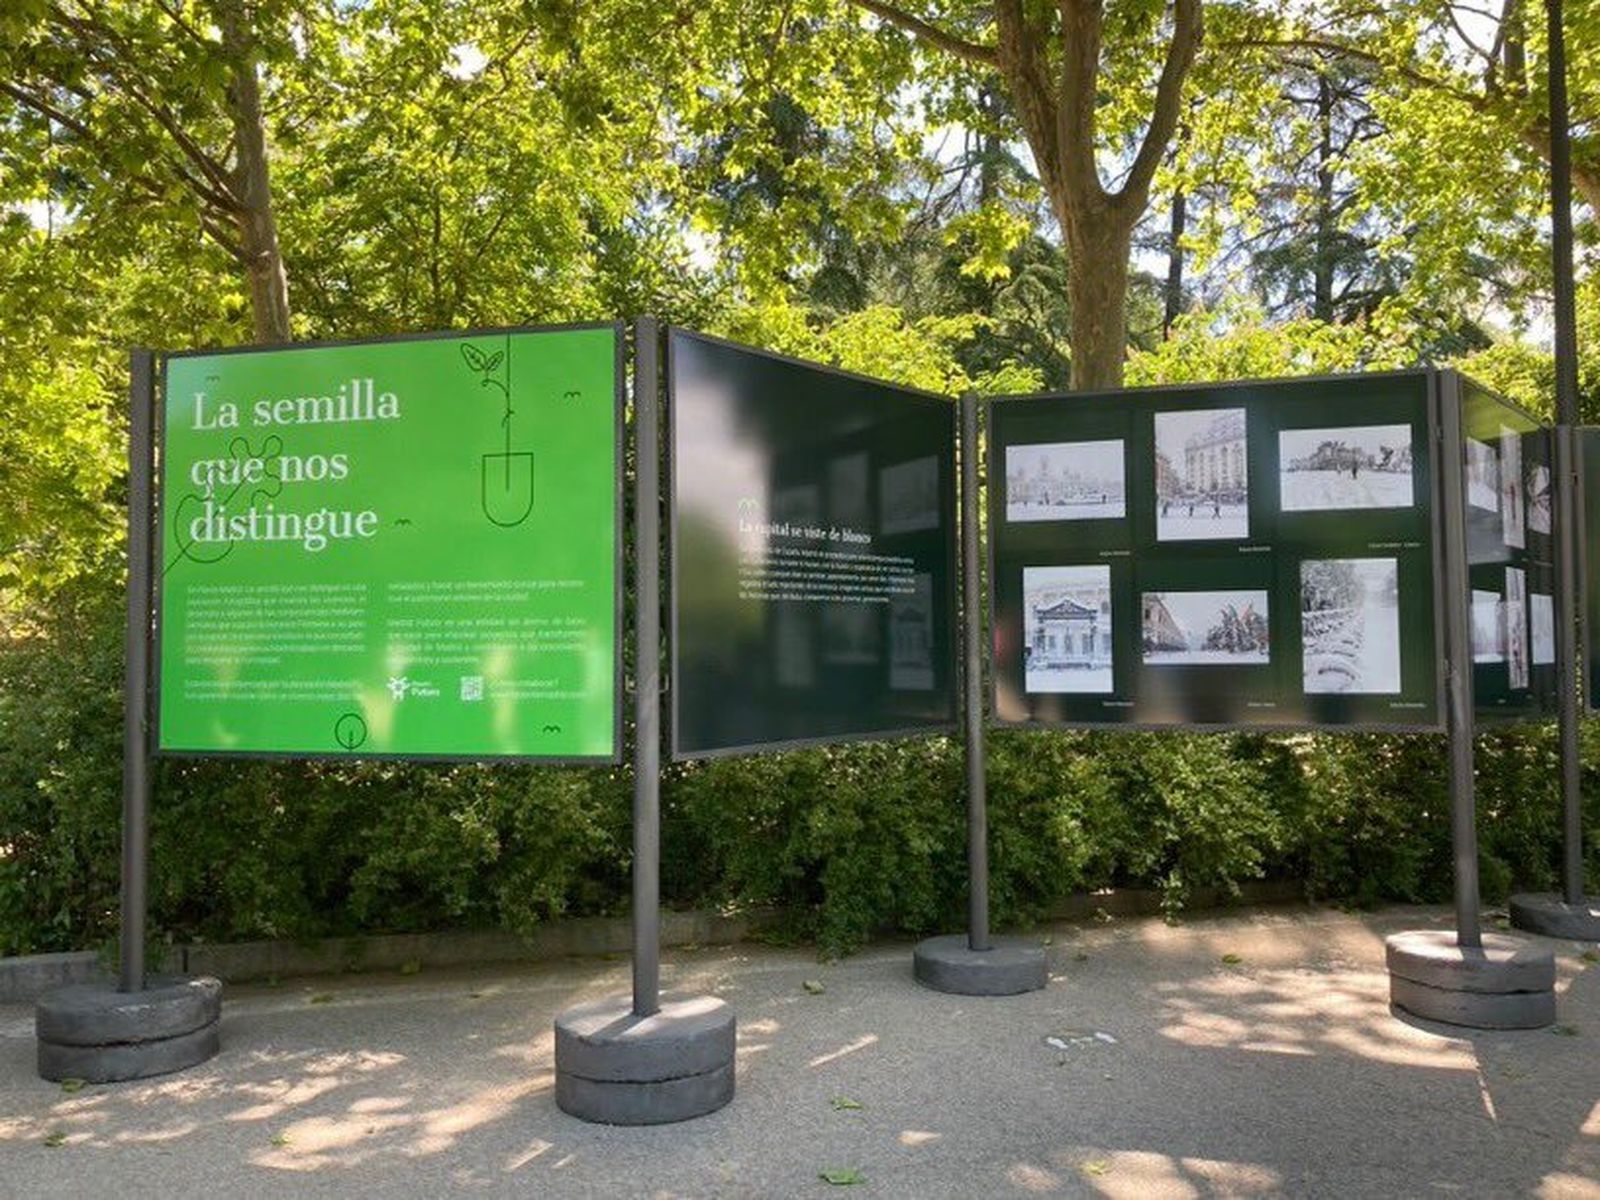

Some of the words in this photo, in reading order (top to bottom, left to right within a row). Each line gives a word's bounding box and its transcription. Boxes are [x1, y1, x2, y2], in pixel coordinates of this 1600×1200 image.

[191, 391, 239, 430] La
[253, 378, 401, 426] semilla
[191, 456, 264, 499] que
[279, 453, 349, 483] nos
[189, 500, 378, 552] distingue
[828, 527, 840, 541] de
